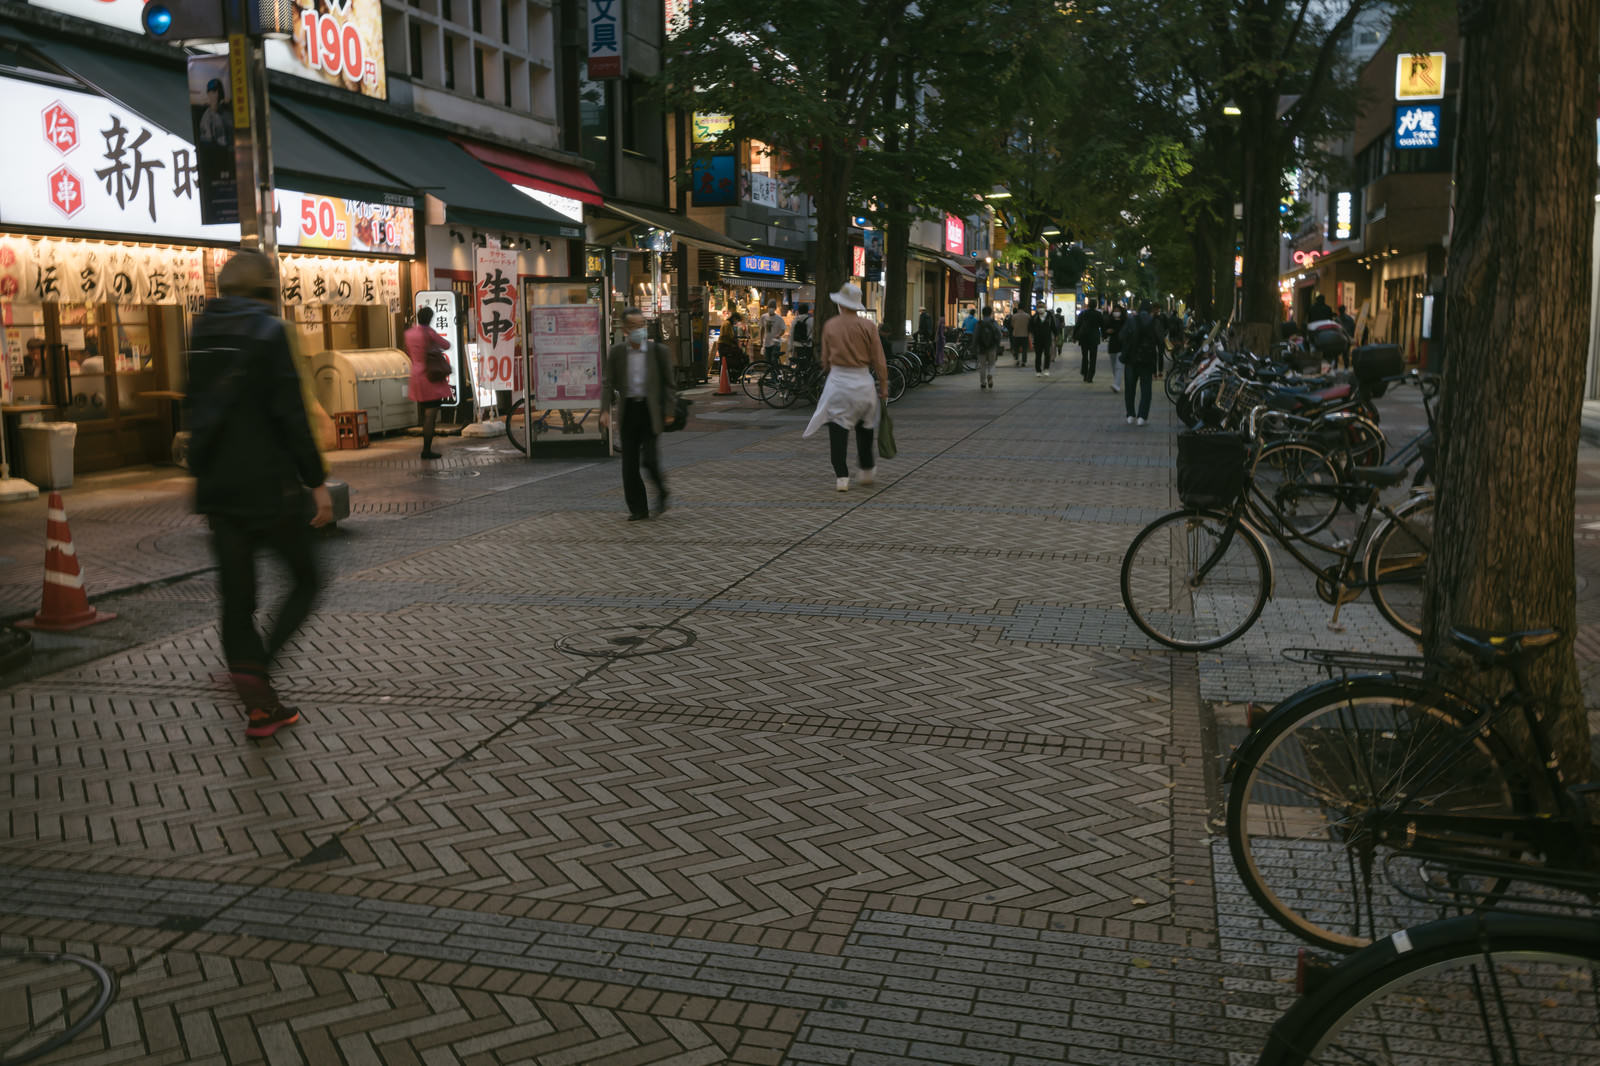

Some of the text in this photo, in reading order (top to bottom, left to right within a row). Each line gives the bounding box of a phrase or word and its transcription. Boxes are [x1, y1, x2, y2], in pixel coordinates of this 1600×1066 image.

[304, 13, 376, 84] 190円
[48, 109, 74, 146] 伝
[57, 170, 78, 212] 串
[481, 268, 513, 350] 生中
